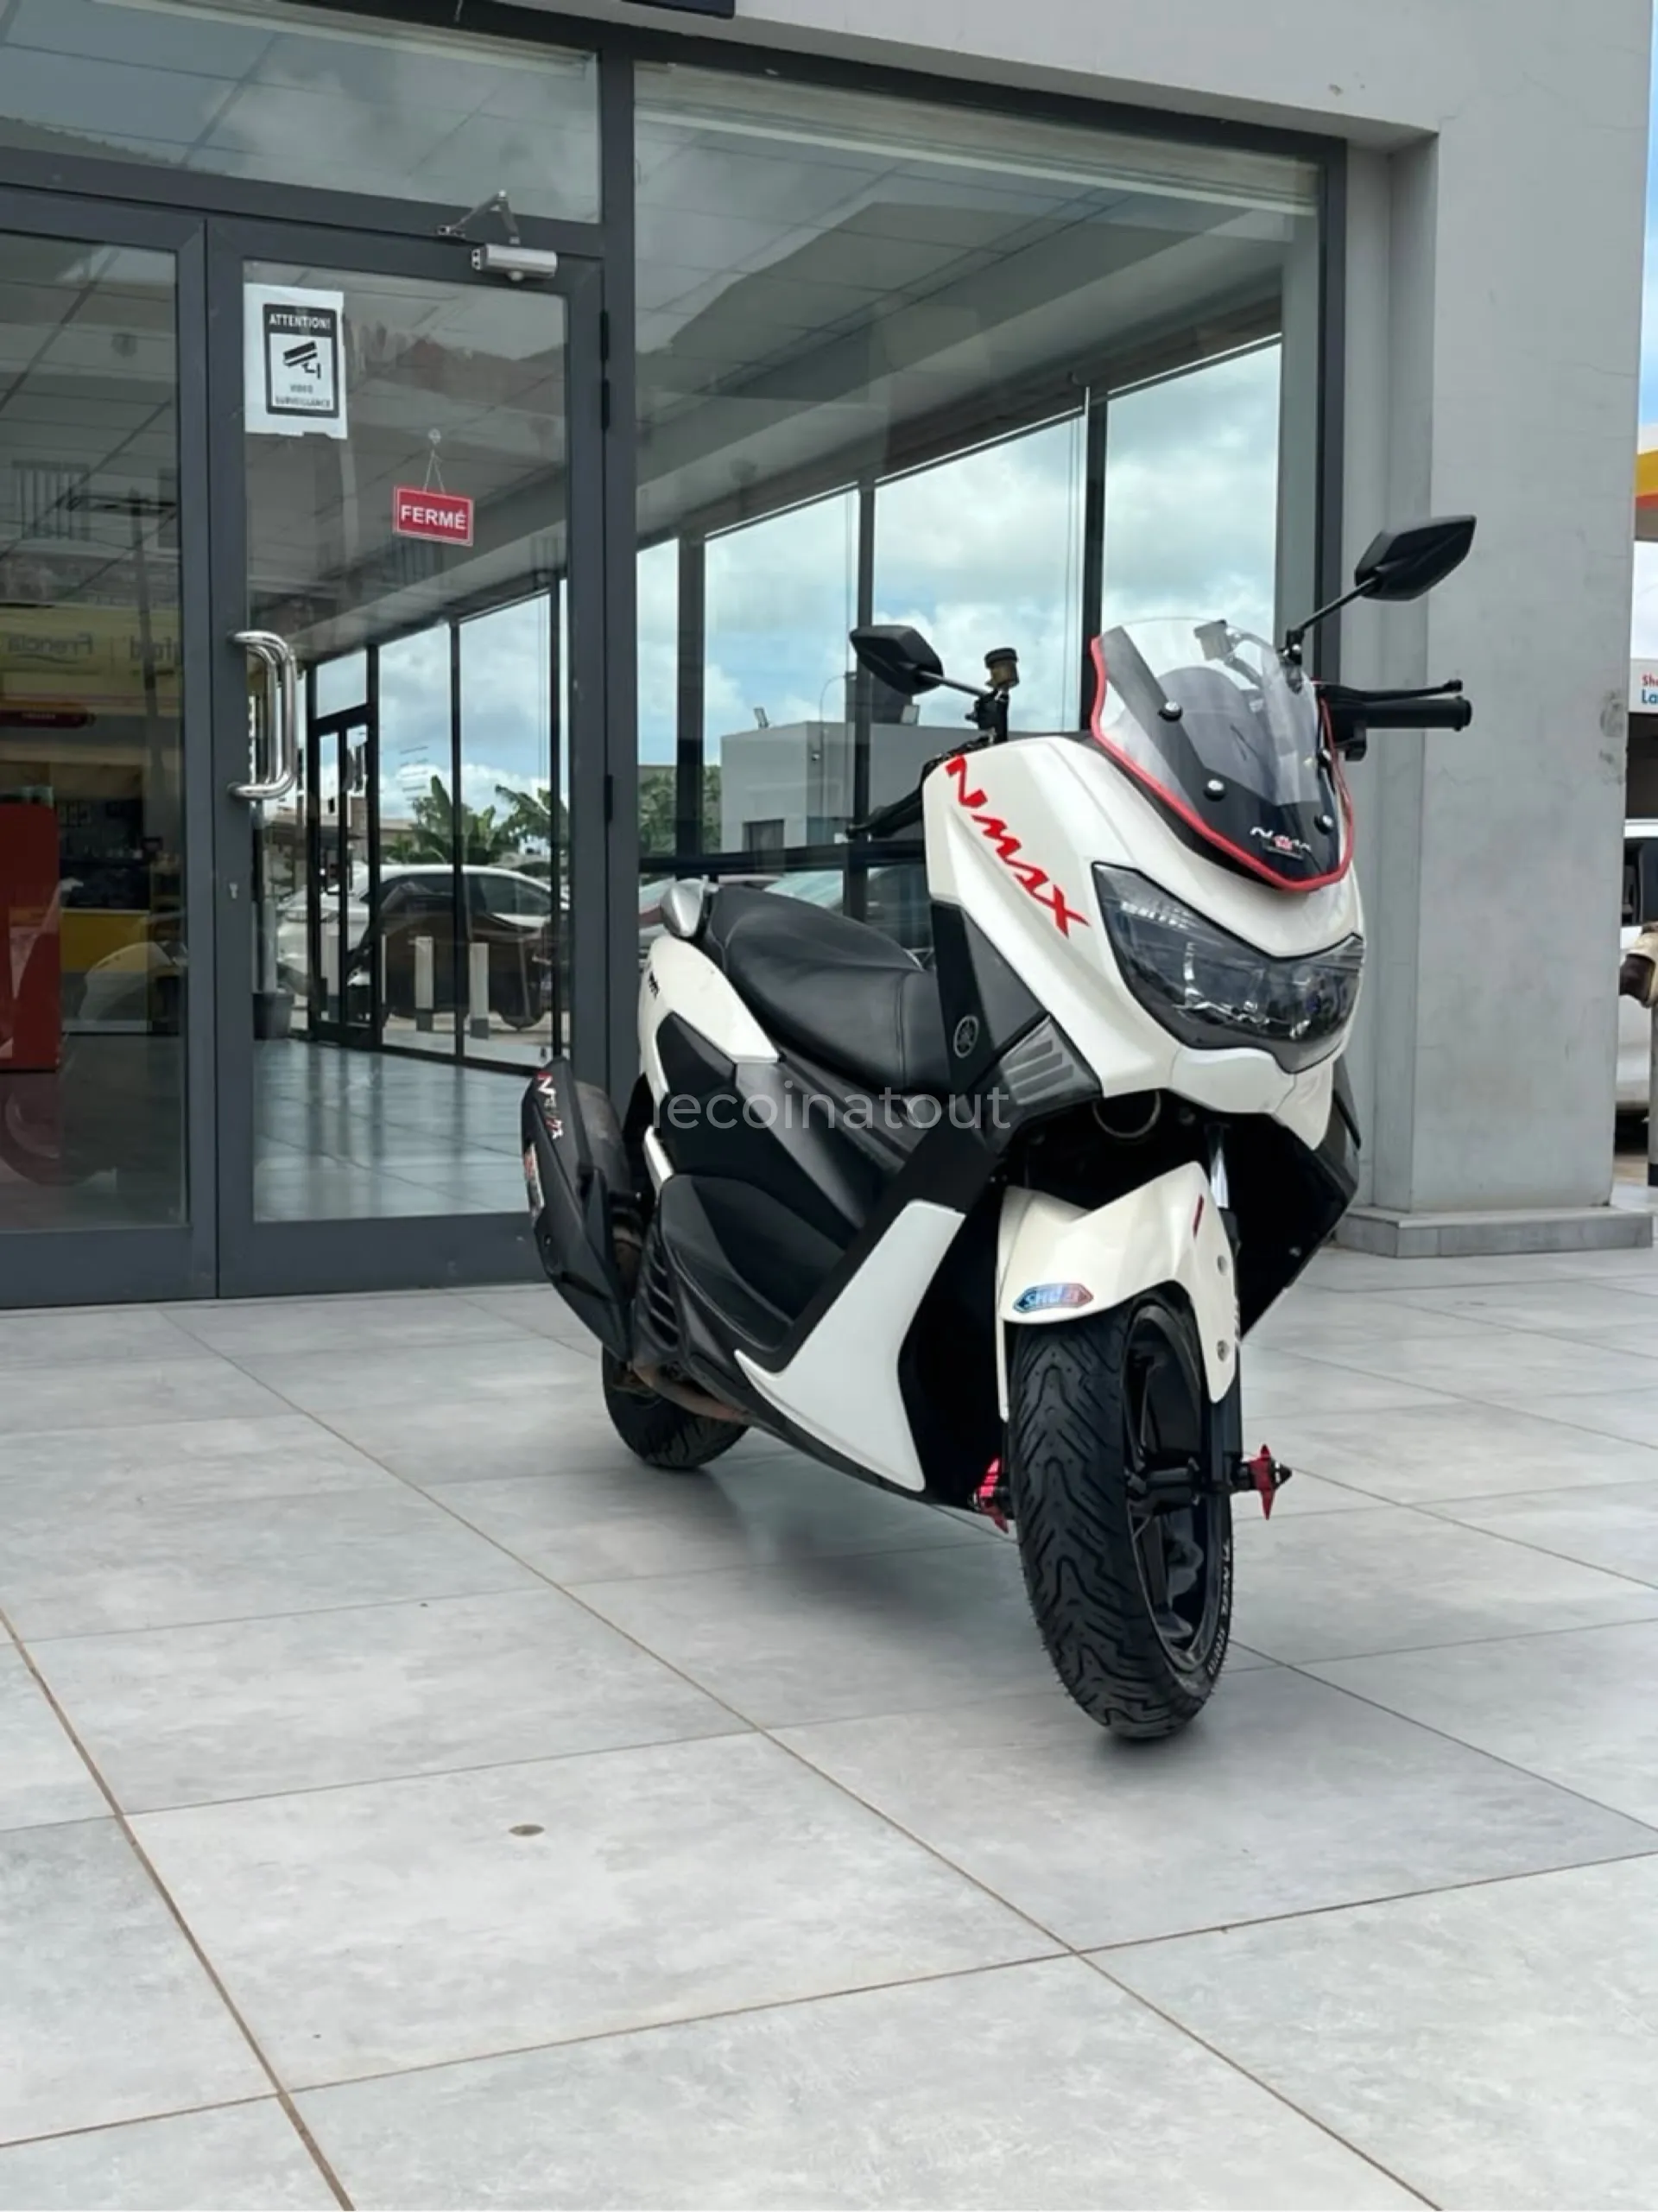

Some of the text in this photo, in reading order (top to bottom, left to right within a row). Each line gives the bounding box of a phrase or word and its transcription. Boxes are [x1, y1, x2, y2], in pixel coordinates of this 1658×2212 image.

[269, 313, 332, 330] ATTENTION!
[401, 504, 467, 530] FERMÉ
[945, 754, 1092, 939] NMAX
